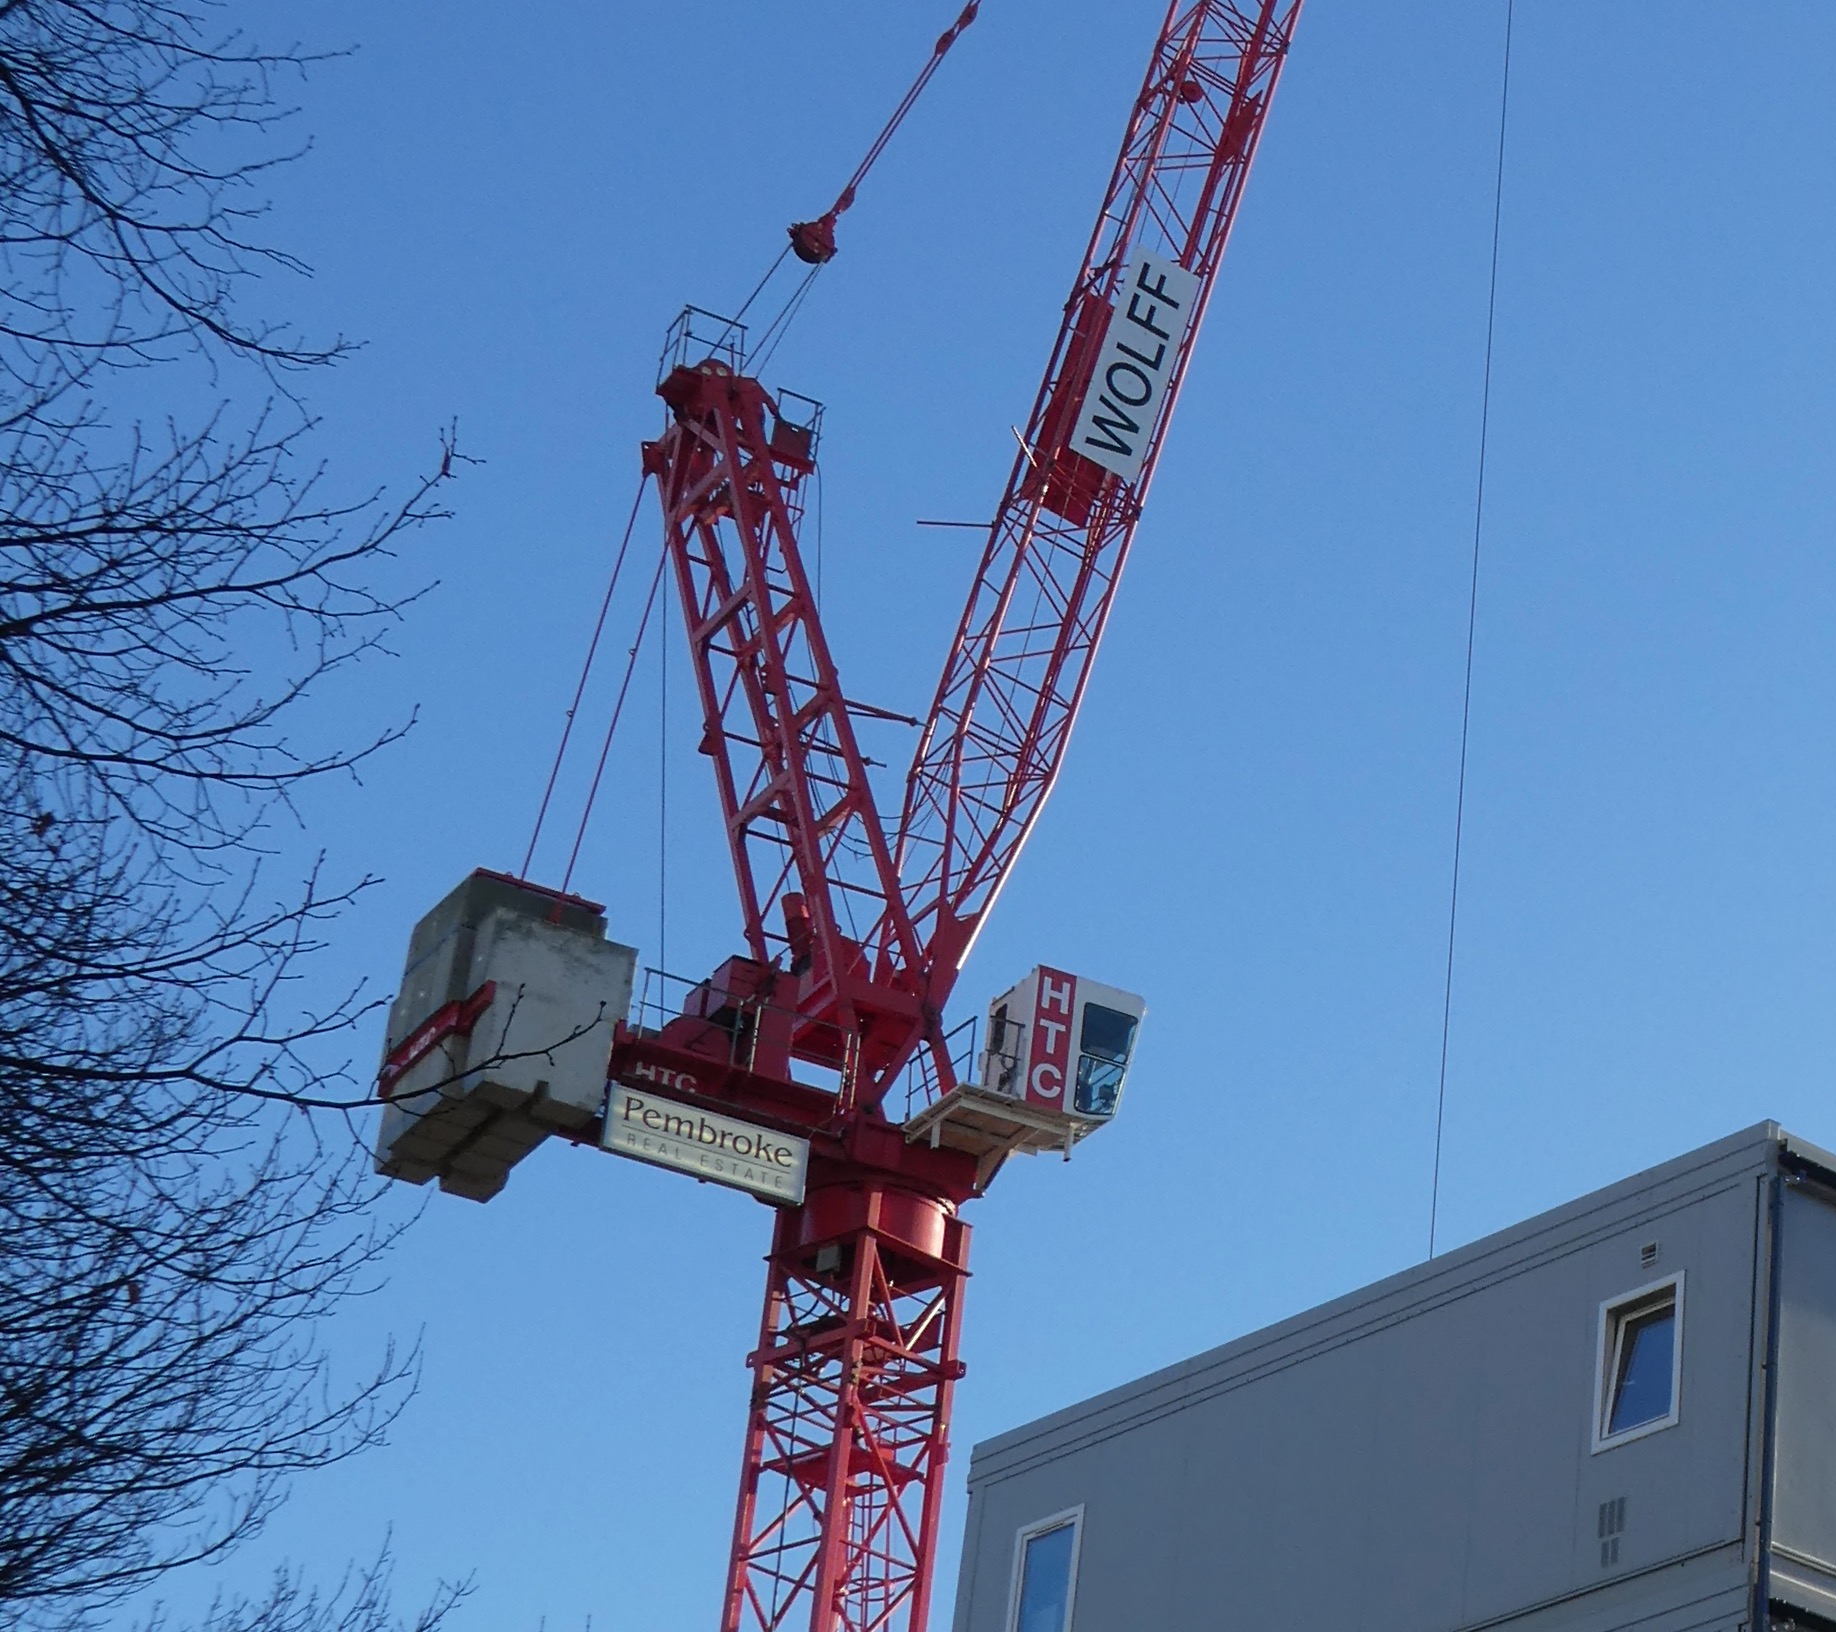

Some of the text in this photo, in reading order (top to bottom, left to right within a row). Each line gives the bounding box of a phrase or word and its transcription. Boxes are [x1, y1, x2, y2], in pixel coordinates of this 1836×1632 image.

[1085, 262, 1180, 456] WOLFF
[1032, 976, 1070, 1098] HTC
[635, 1061, 697, 1093] HTC
[624, 1096, 792, 1168] Pembroke
[627, 1133, 783, 1188] REAL ESTATE
